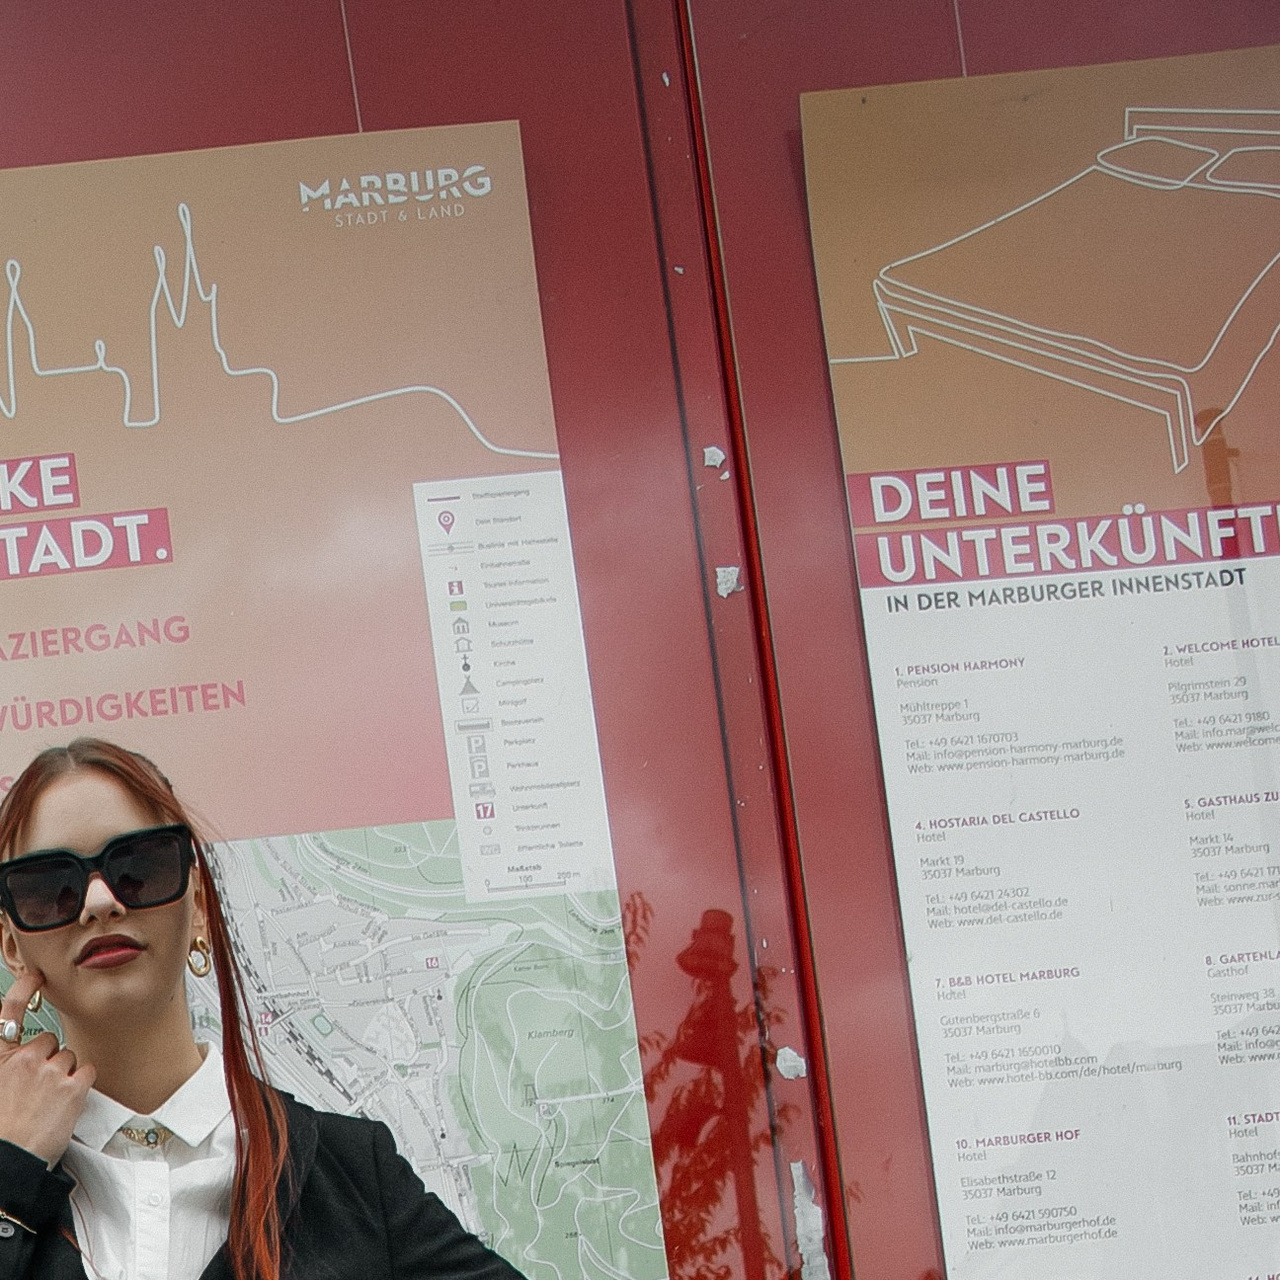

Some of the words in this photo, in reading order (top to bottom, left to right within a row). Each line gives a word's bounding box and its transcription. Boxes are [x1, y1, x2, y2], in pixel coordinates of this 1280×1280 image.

[299, 164, 492, 213] MARBURG
[335, 210, 388, 228] STADT
[398, 209, 408, 222] &
[417, 203, 466, 220] LAND
[869, 463, 1051, 523] DEINE
[877, 503, 1280, 584] UNTERKÜNFT
[886, 594, 909, 613] IN
[916, 591, 961, 611] DER
[967, 580, 1105, 607] MARBURGER
[1111, 567, 1247, 596] INNENSTADT
[1162, 645, 1173, 656] 2.
[1175, 638, 1239, 654] WELCOME
[894, 666, 904, 676] 1.
[906, 662, 960, 676] PENSION
[963, 656, 1025, 671] HARMONY
[896, 676, 938, 689] Pension
[899, 700, 961, 713] Mühltreppe
[963, 698, 968, 709] 1
[901, 713, 932, 726] 35037
[934, 710, 981, 723] Marburg
[1183, 798, 1194, 809] 5.
[1197, 792, 1261, 808] GASTHAUS
[476, 803, 494, 819] 17
[915, 820, 926, 830] 4.
[928, 815, 989, 829] HOSTARIA
[991, 813, 1016, 825] DEL
[1018, 807, 1080, 823] CASTELLO
[916, 830, 946, 843] Hotel
[919, 855, 951, 868] Markt
[953, 854, 965, 865] 19
[921, 867, 953, 880] 35037
[955, 865, 1001, 877] Marburg
[1205, 955, 1216, 966] 8.
[935, 977, 945, 989] 7.
[948, 975, 973, 988] B&B
[976, 972, 1016, 985] HOTEL
[1019, 966, 1080, 982] MARBURG
[936, 988, 967, 1001] Hotel
[1032, 1007, 1041, 1019] 6
[941, 1025, 973, 1039] 35037
[975, 1023, 1022, 1035] Marburg
[1226, 1113, 1242, 1126] 11.
[955, 1138, 972, 1149] 10.
[975, 1131, 1052, 1148] MARBURGER
[1054, 1128, 1081, 1141] HOF
[956, 1150, 987, 1162] Hotel
[1045, 1168, 1057, 1180] 12
[961, 1187, 993, 1201] 35037
[996, 1185, 1042, 1197] Marburg
